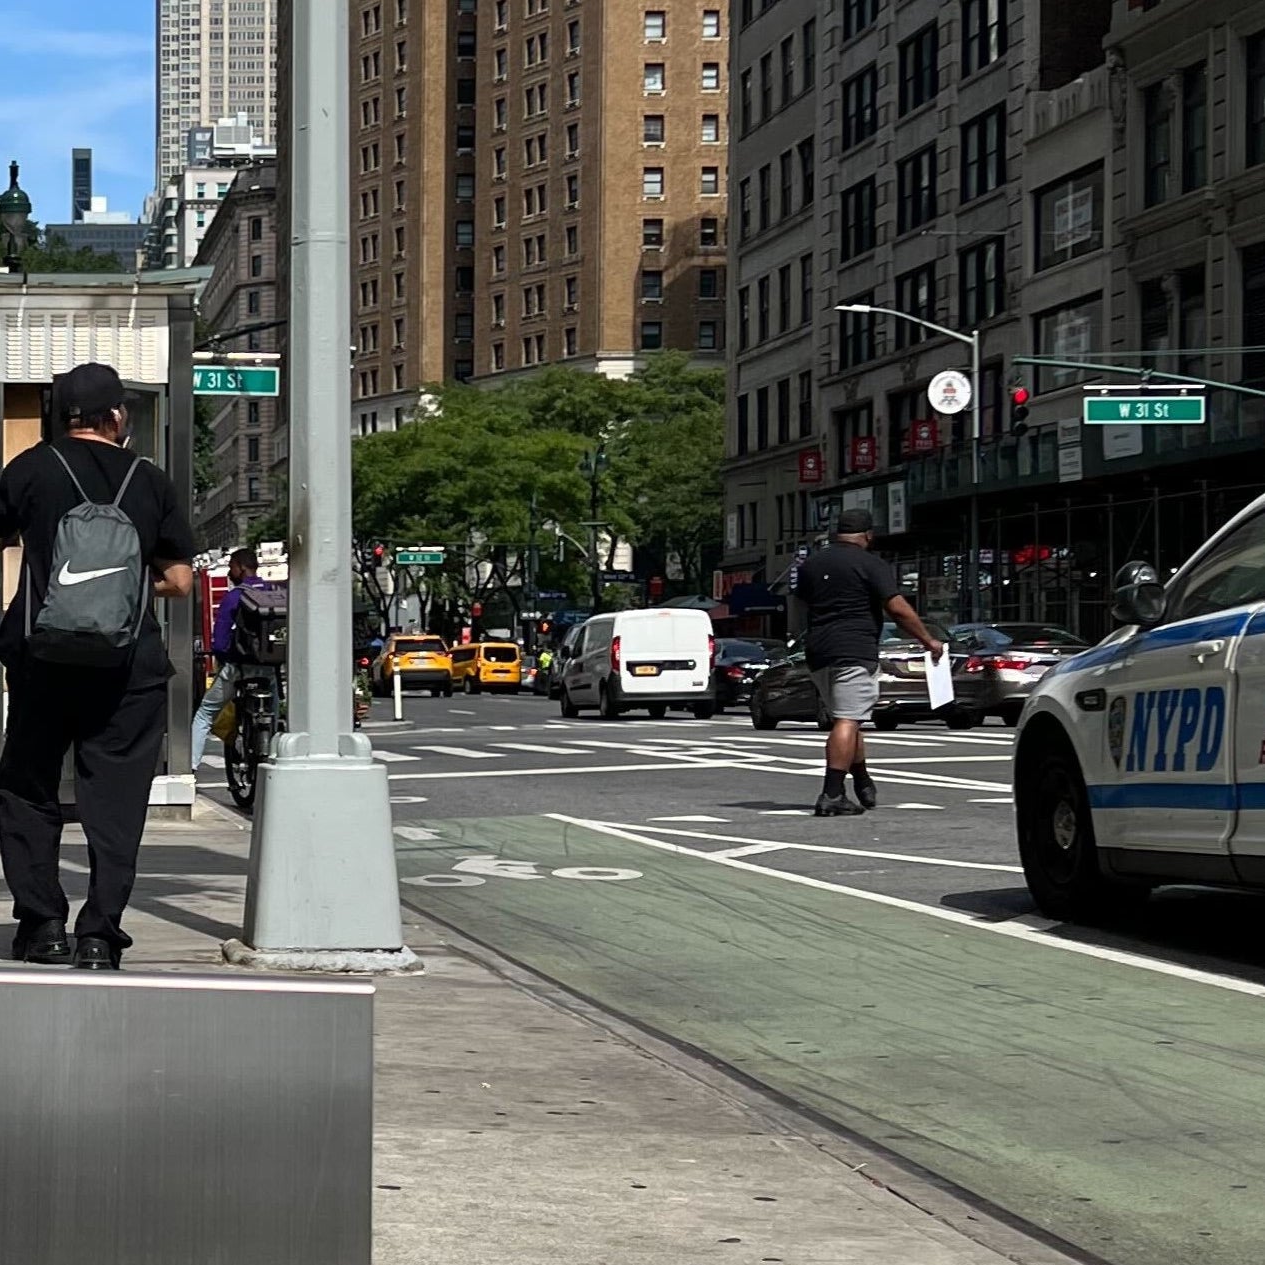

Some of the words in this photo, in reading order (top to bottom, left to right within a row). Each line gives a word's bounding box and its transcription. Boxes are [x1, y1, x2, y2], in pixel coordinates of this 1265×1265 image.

[207, 372, 222, 388] 31
[227, 372, 244, 388] St
[1118, 403, 1131, 418] W
[1134, 402, 1149, 418] 31
[1153, 402, 1170, 418] St
[1125, 686, 1226, 772] NYPD
